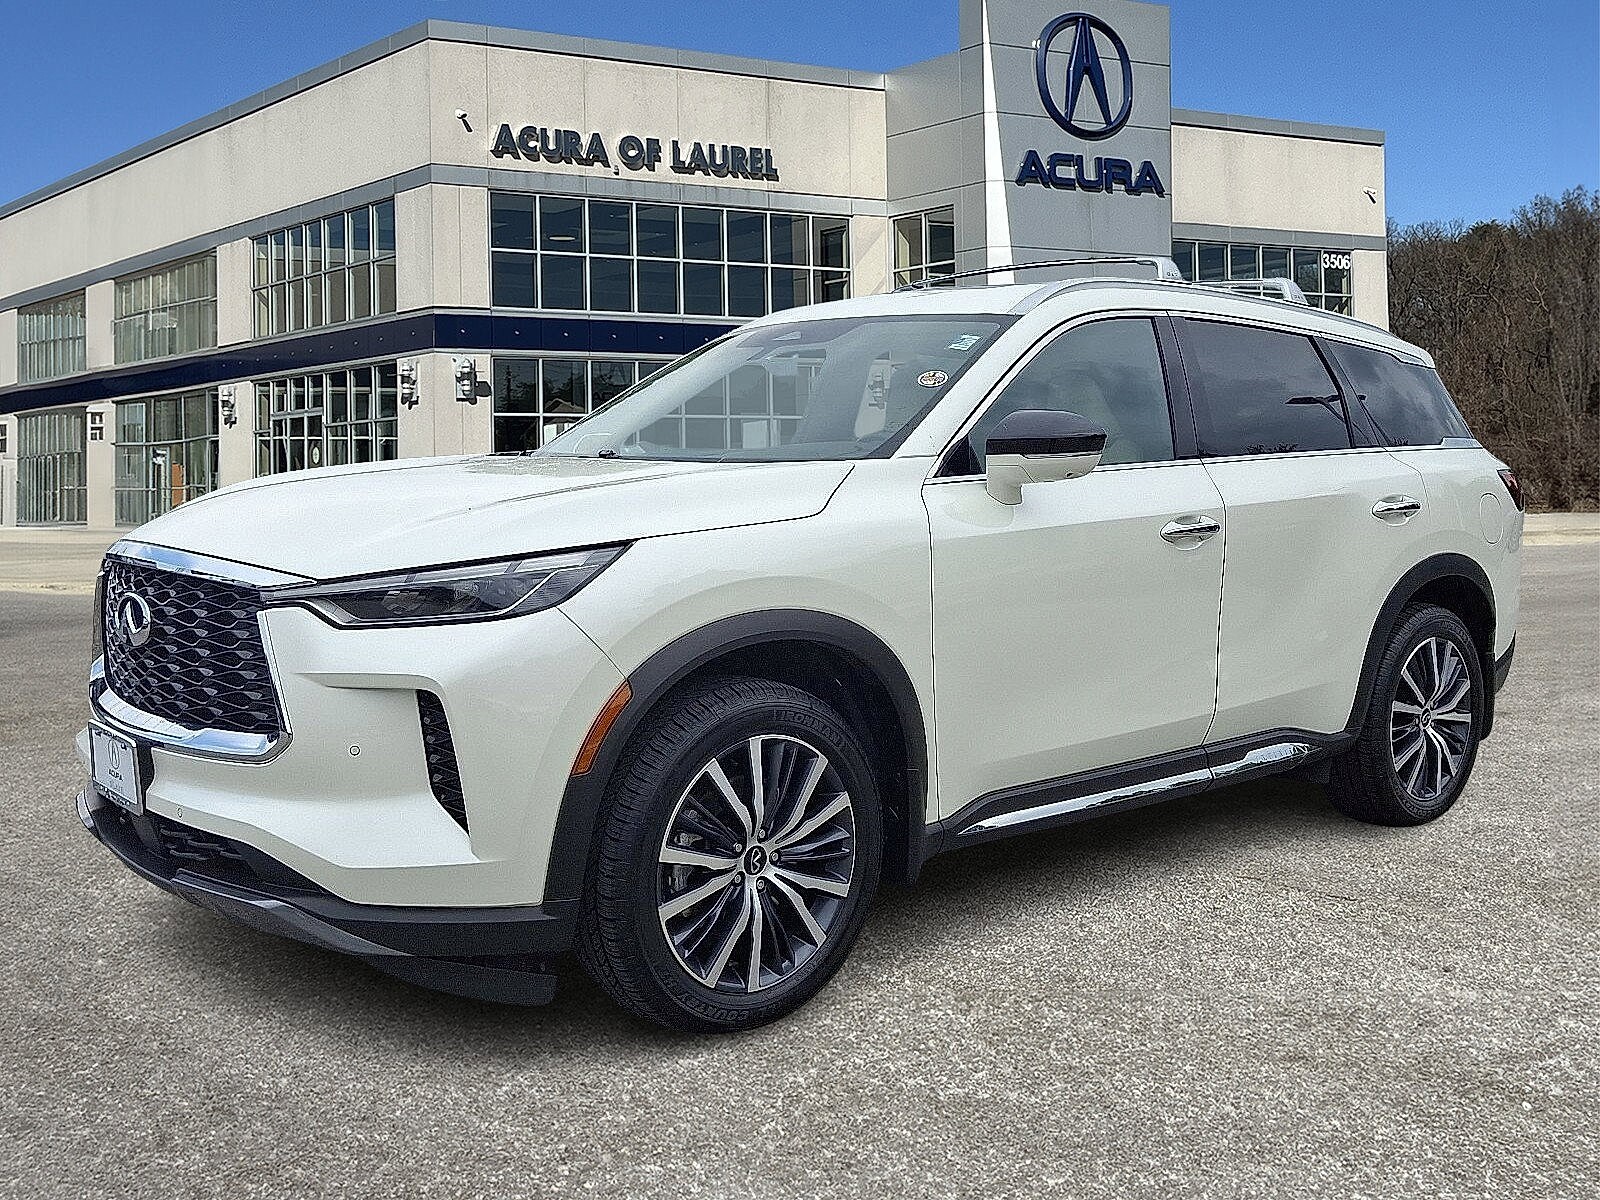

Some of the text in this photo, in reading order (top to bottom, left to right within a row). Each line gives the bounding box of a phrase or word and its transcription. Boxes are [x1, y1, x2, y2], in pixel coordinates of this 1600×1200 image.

[490, 123, 779, 181] ACURA OF LAUREL
[1014, 150, 1166, 198] ACURA
[1322, 253, 1351, 270] 3506
